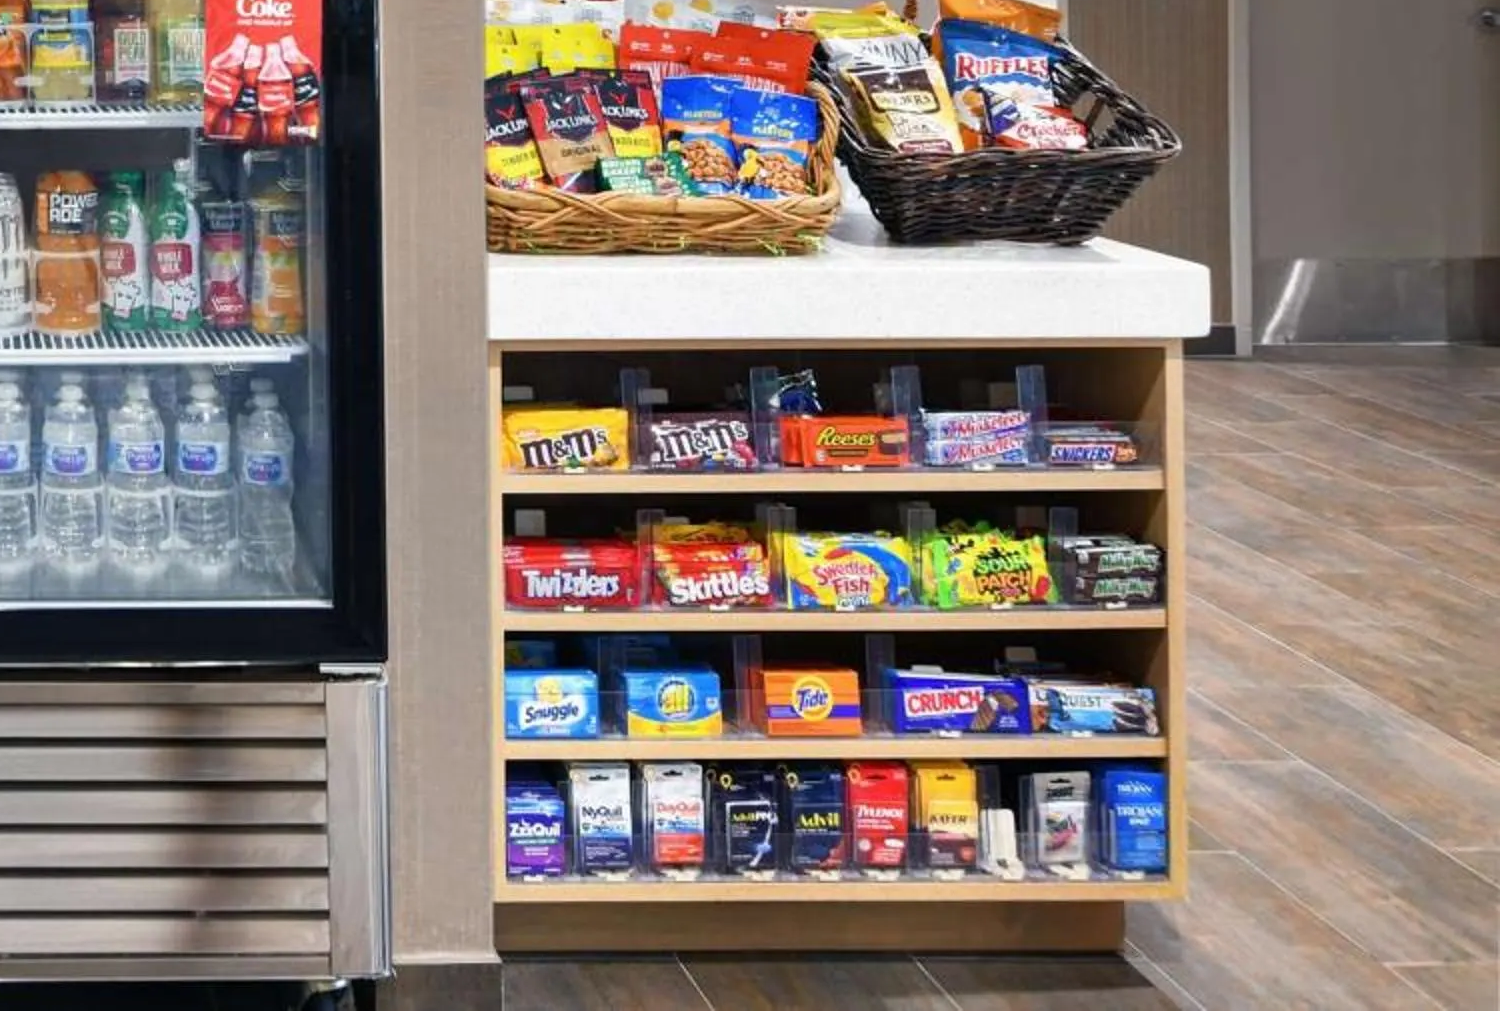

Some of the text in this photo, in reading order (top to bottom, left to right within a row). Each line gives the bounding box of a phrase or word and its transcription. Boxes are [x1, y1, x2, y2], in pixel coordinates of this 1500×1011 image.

[486, 124, 513, 140] JACK
[546, 120, 571, 132] JACK
[561, 144, 601, 157] ORIGINAL
[1051, 445, 1113, 462] SNICKERS
[977, 554, 1025, 574] SOUR
[521, 567, 620, 599] Twizzlers
[671, 570, 770, 605] Skittles
[976, 569, 1033, 591] PATCH
[662, 683, 689, 713] all
[796, 688, 829, 712] Tide
[906, 690, 982, 714] CRUNCH
[525, 702, 580, 724] Snuggle
[582, 806, 624, 820] NyQuil
[656, 802, 701, 816] DayQuil
[857, 805, 904, 819] TYLENOL
[1116, 803, 1164, 817] TROJAN
[799, 811, 840, 827] Advil
